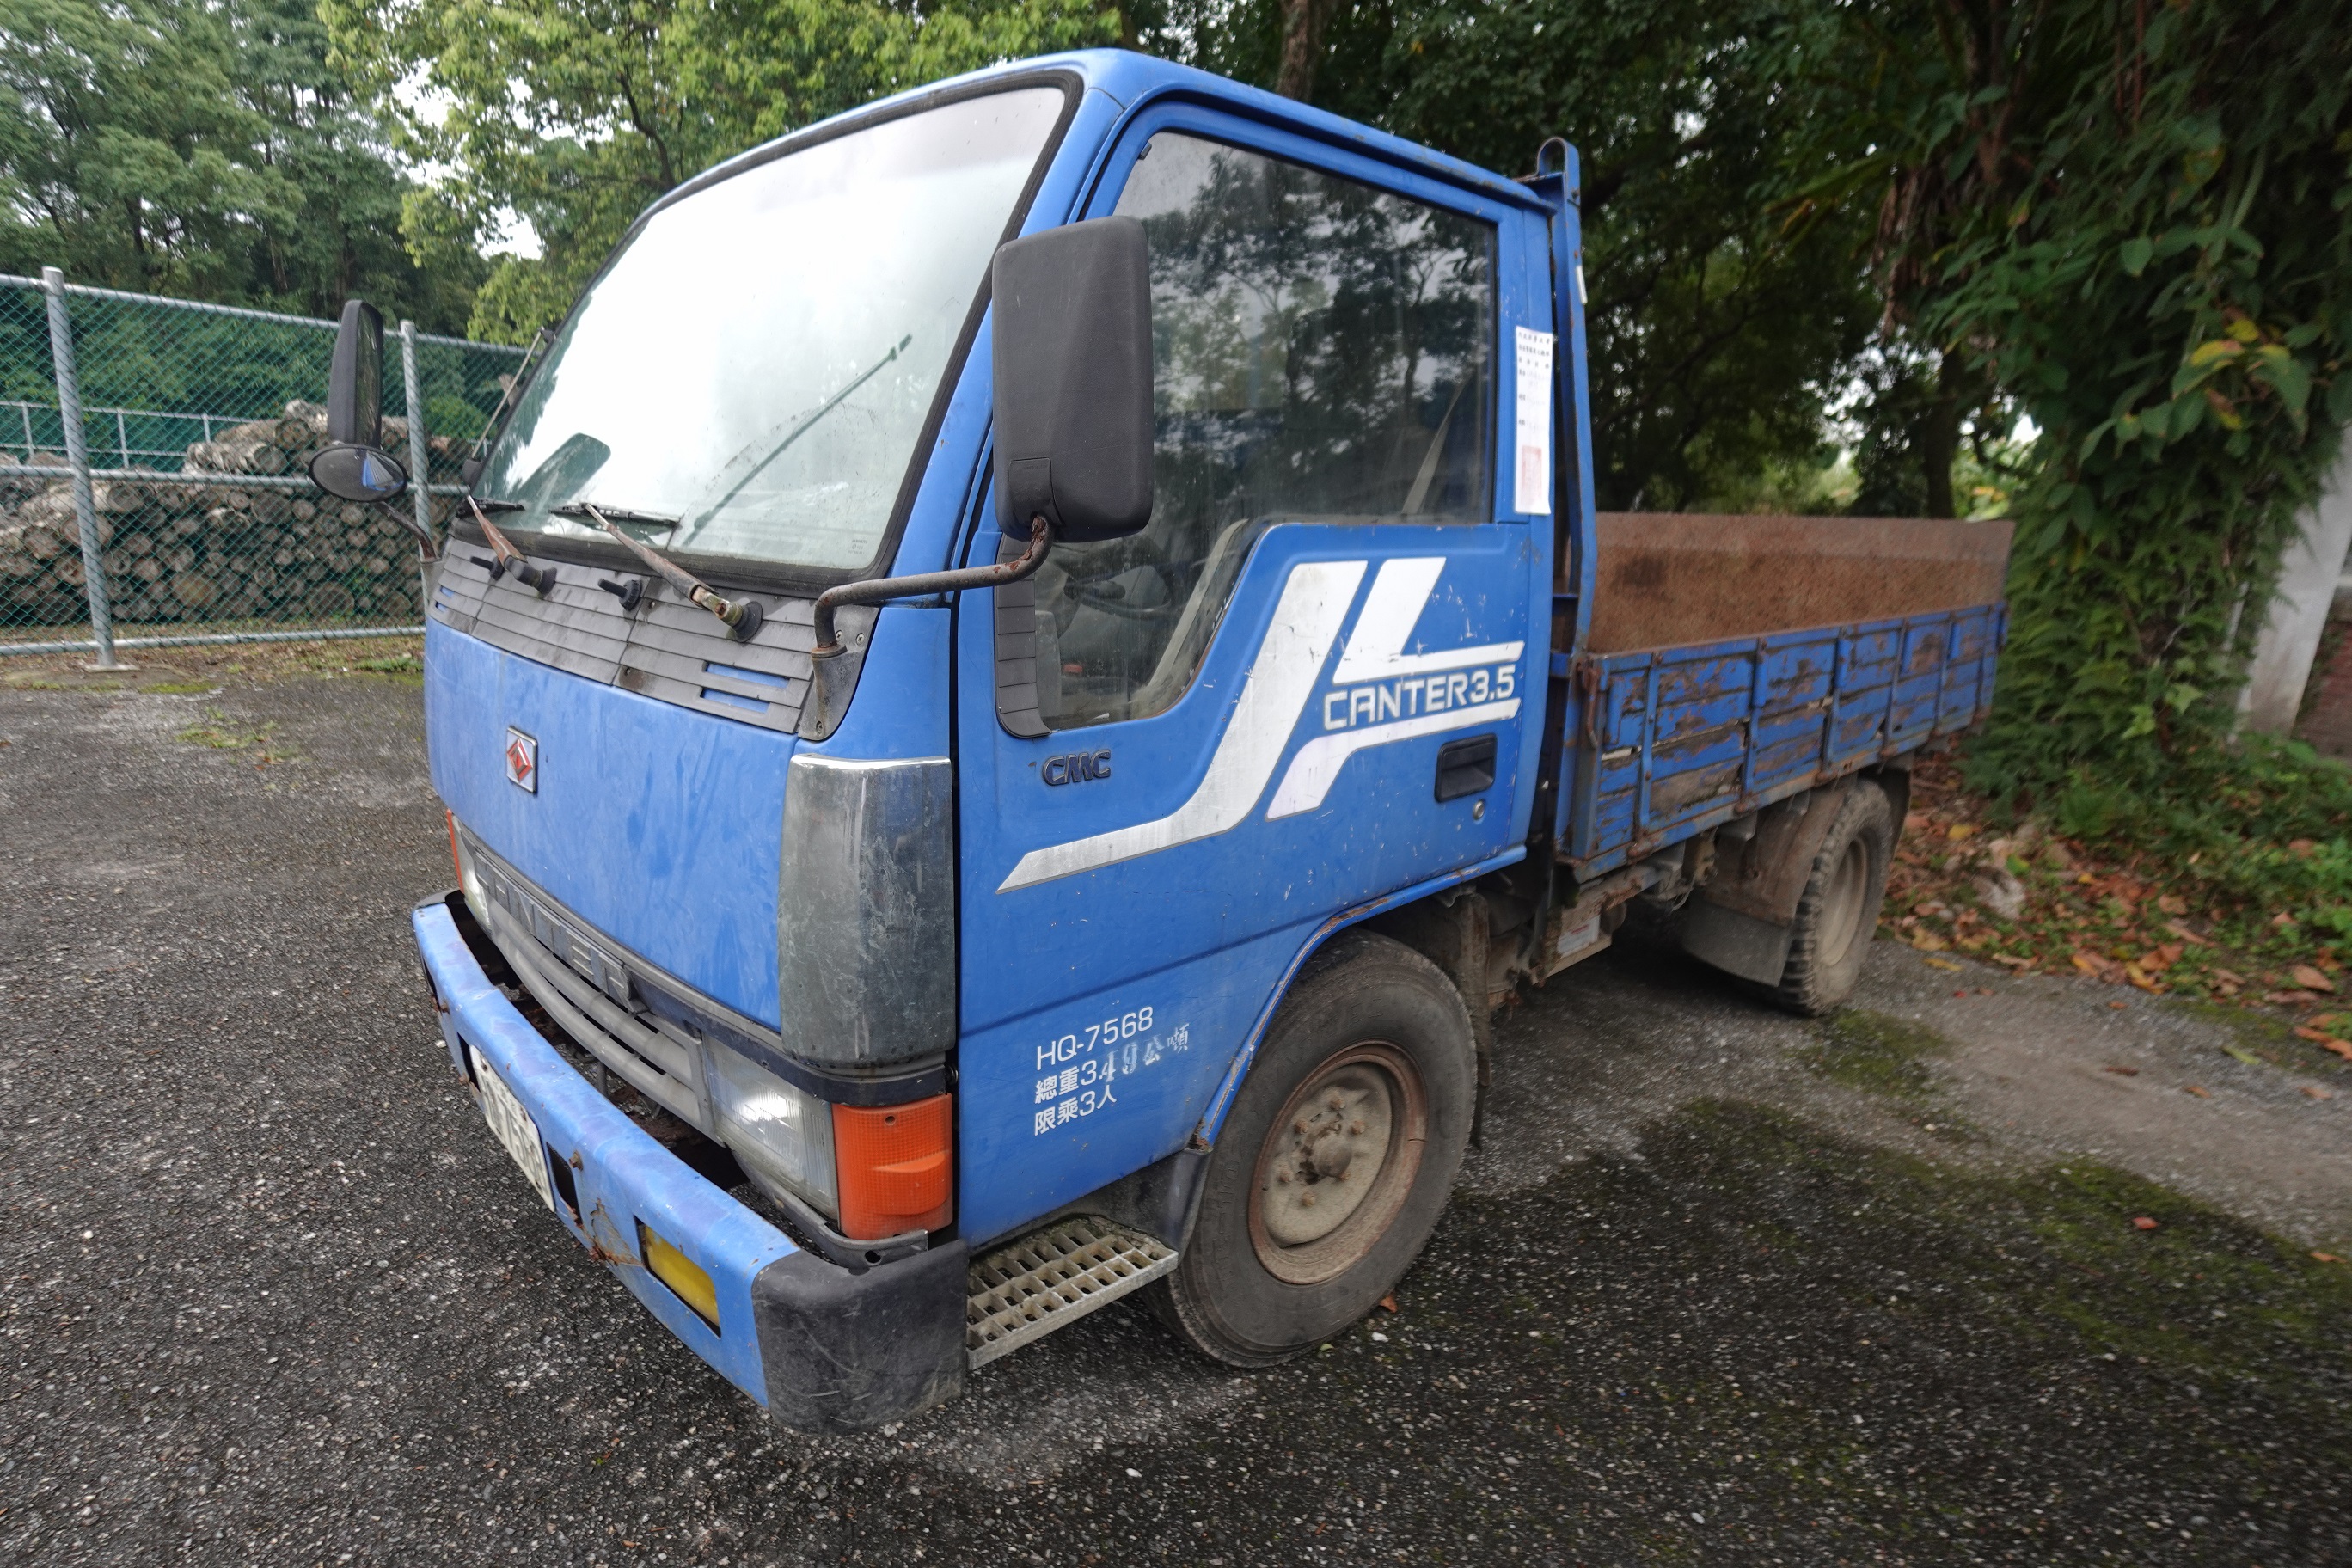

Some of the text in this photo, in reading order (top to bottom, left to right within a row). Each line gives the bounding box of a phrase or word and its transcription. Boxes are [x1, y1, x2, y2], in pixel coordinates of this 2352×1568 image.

[1042, 750, 1111, 786] CMC
[1037, 1006, 1154, 1070] HQ-7568
[1034, 1085, 1117, 1136] 限乘3人
